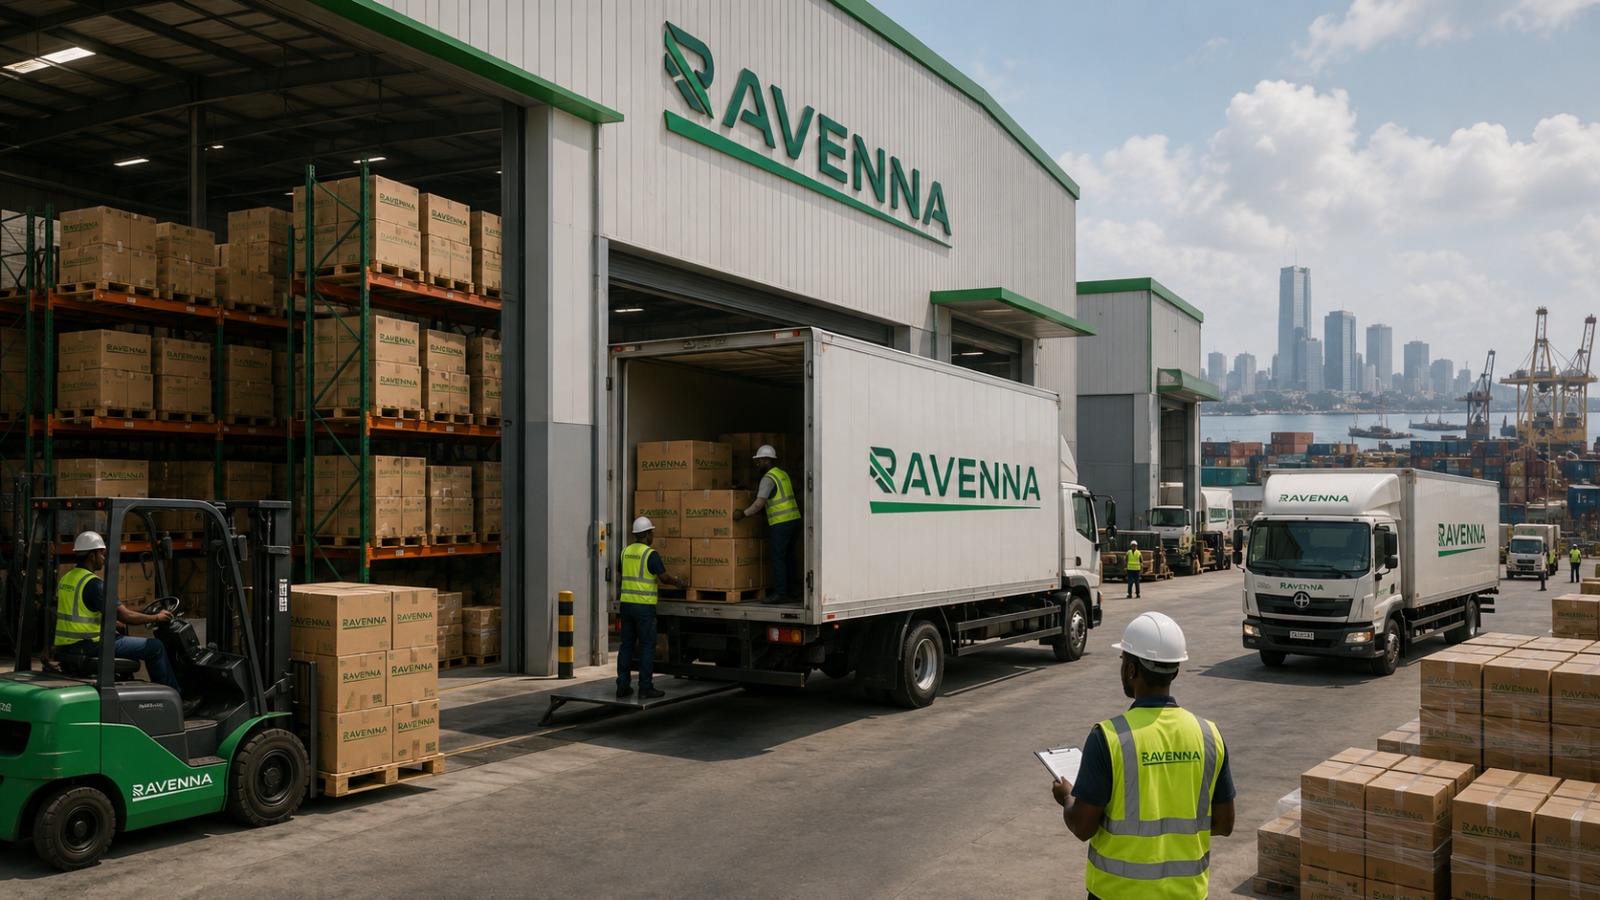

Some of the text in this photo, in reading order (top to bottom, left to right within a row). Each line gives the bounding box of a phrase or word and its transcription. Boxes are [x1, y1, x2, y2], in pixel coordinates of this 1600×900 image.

[665, 20, 951, 236] RAVENNA
[106, 343, 148, 355] RAVENNA
[380, 375, 418, 386] RAVENNA
[641, 460, 687, 469] RAVENNA
[100, 471, 144, 479] RAVENNA
[870, 446, 1041, 501] RAVENNA
[1278, 493, 1349, 503] RAVENNA
[685, 508, 728, 516] RAVENNA
[1437, 523, 1486, 547] RAVENNA
[342, 616, 387, 628] RAVENNA
[397, 611, 433, 622] RAVENNA
[391, 662, 434, 674] RAVENNA
[343, 669, 382, 681] RAVENNA
[1491, 682, 1540, 695] RAVENNA
[1141, 751, 1201, 763] RAVENNA
[132, 773, 213, 797] RAVENNA
[1461, 822, 1521, 839] RAVENNA
